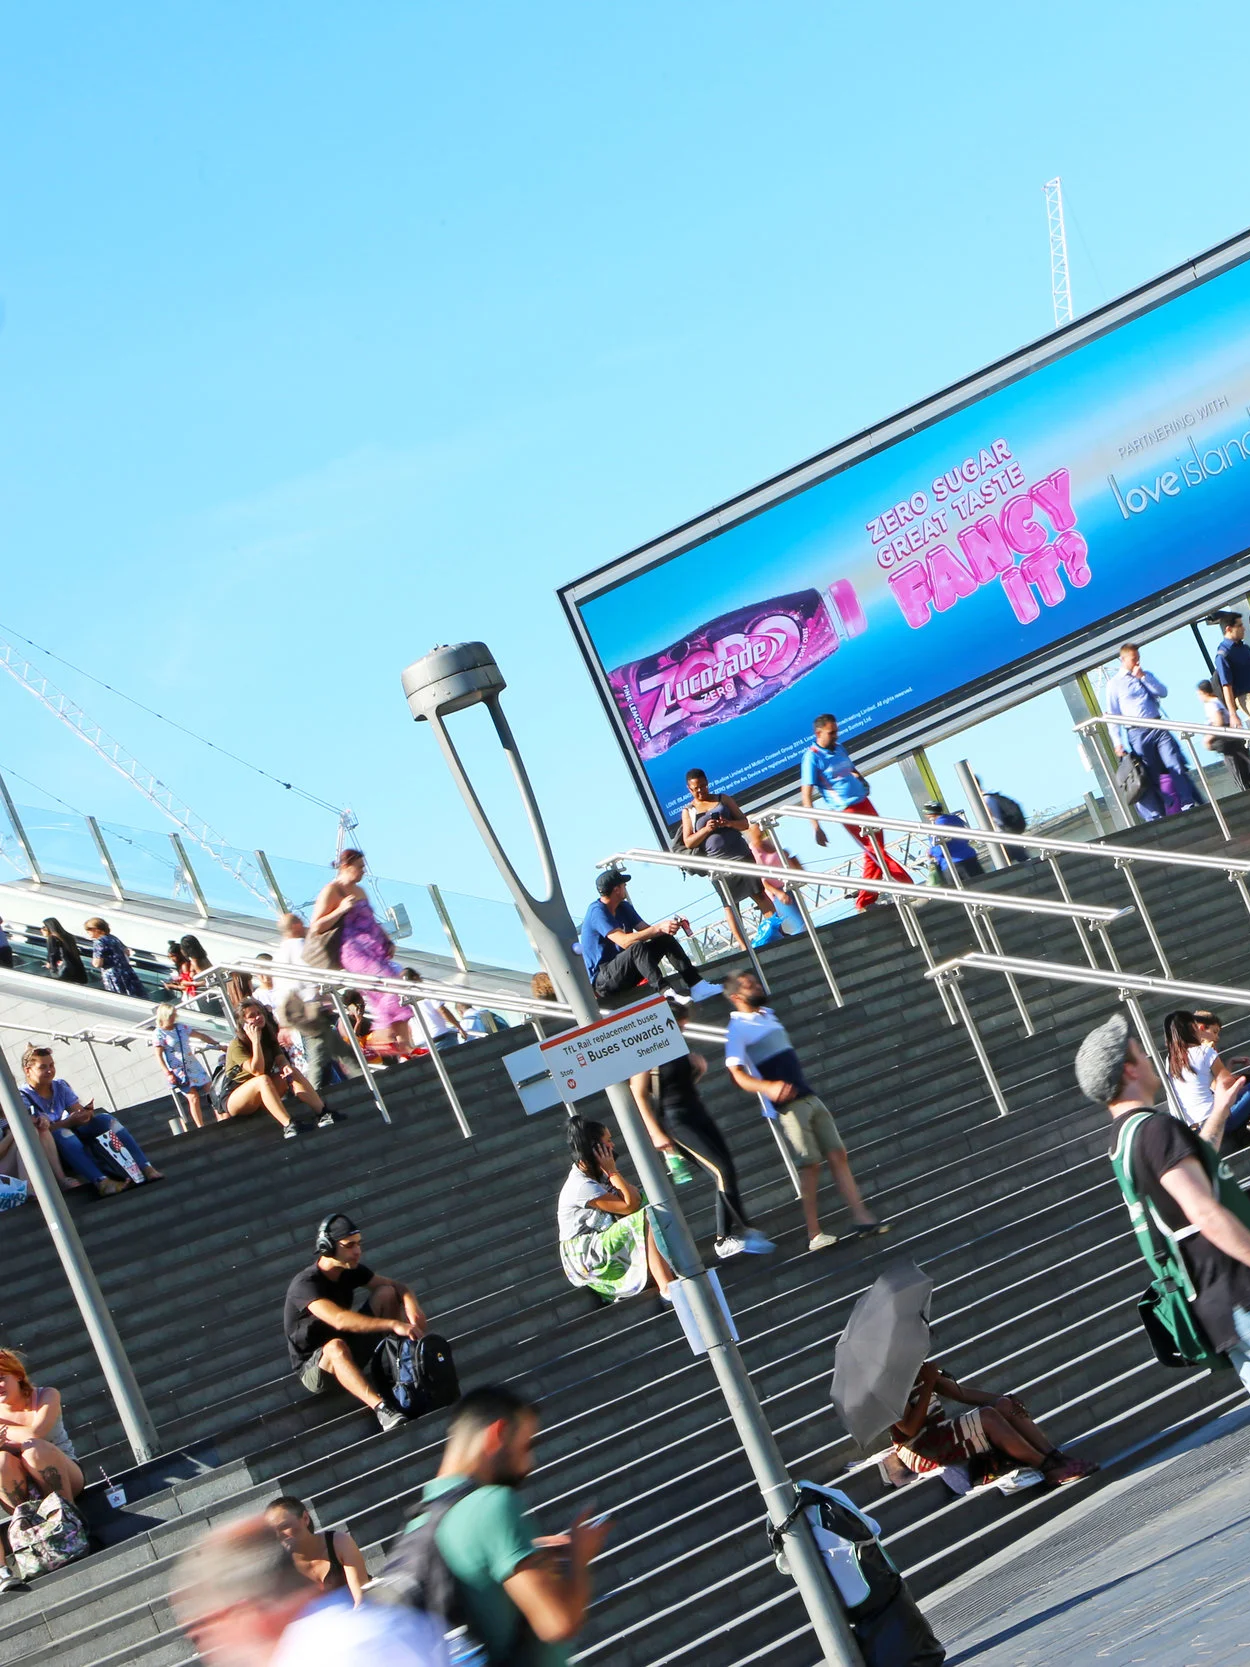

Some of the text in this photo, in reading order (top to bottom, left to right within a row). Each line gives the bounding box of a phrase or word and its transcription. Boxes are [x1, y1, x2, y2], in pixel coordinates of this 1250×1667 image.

[1118, 395, 1230, 459] PARTNERING WITH
[866, 437, 1013, 544] ZERO SUGAR
[877, 461, 1026, 570] GREAT TASTE
[1107, 473, 1182, 519] love
[887, 467, 1078, 629] FANCY
[1000, 530, 1092, 625] IT?
[663, 640, 768, 707] Lucozade
[700, 681, 736, 704] ZERO
[622, 684, 651, 743] PINK LEMONADE
[562, 1011, 659, 1056] TfL Rail replacement buses
[587, 1023, 665, 1063] Buses towards
[636, 1038, 671, 1058] Shenfield
[560, 1067, 574, 1079] Stop
